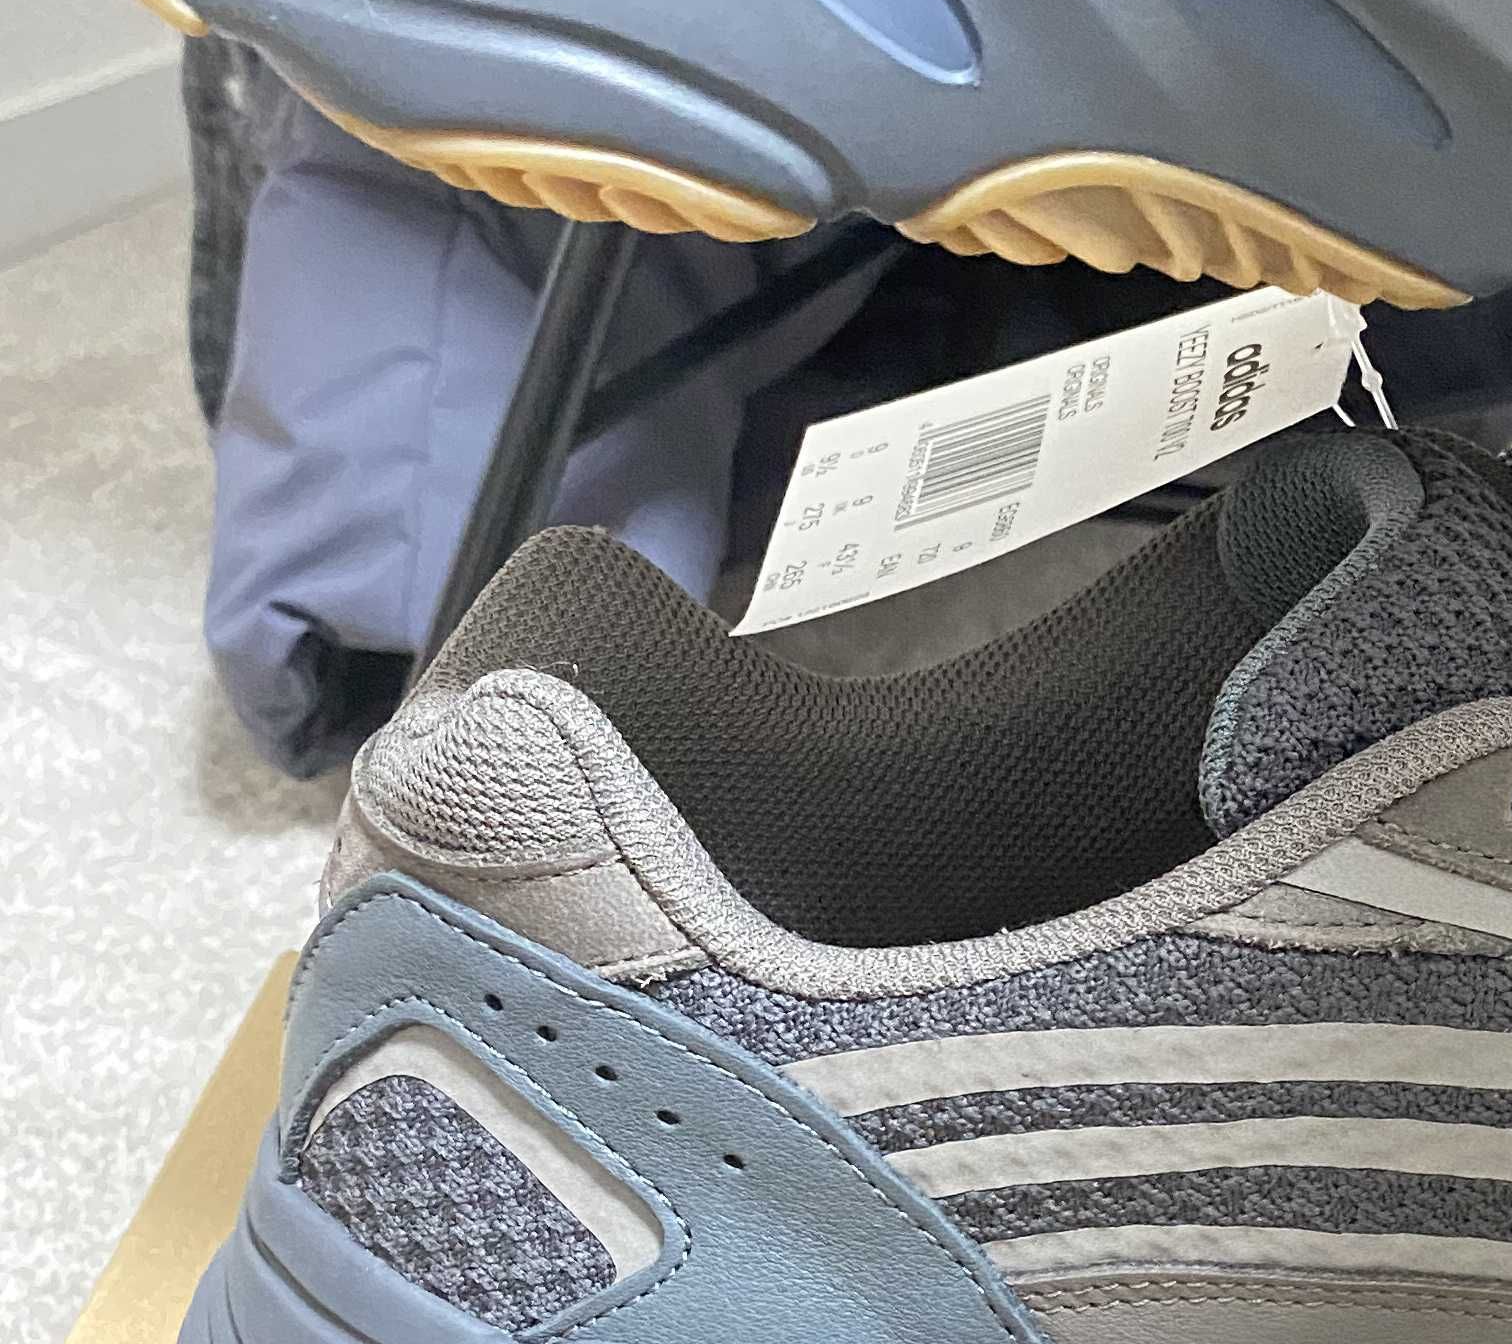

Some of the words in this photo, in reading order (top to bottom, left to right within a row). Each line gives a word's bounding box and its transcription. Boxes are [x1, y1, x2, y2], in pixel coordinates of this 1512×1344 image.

[1176, 324, 1212, 371] YEEZY
[1058, 363, 1086, 421] ORIGINALS
[1084, 355, 1111, 413] ORIGINALS
[1166, 369, 1205, 420] BOOST
[1210, 343, 1270, 431] adidas
[867, 441, 889, 454] 9
[798, 502, 825, 531] 275
[852, 494, 874, 507] 9
[779, 560, 808, 591] 265
